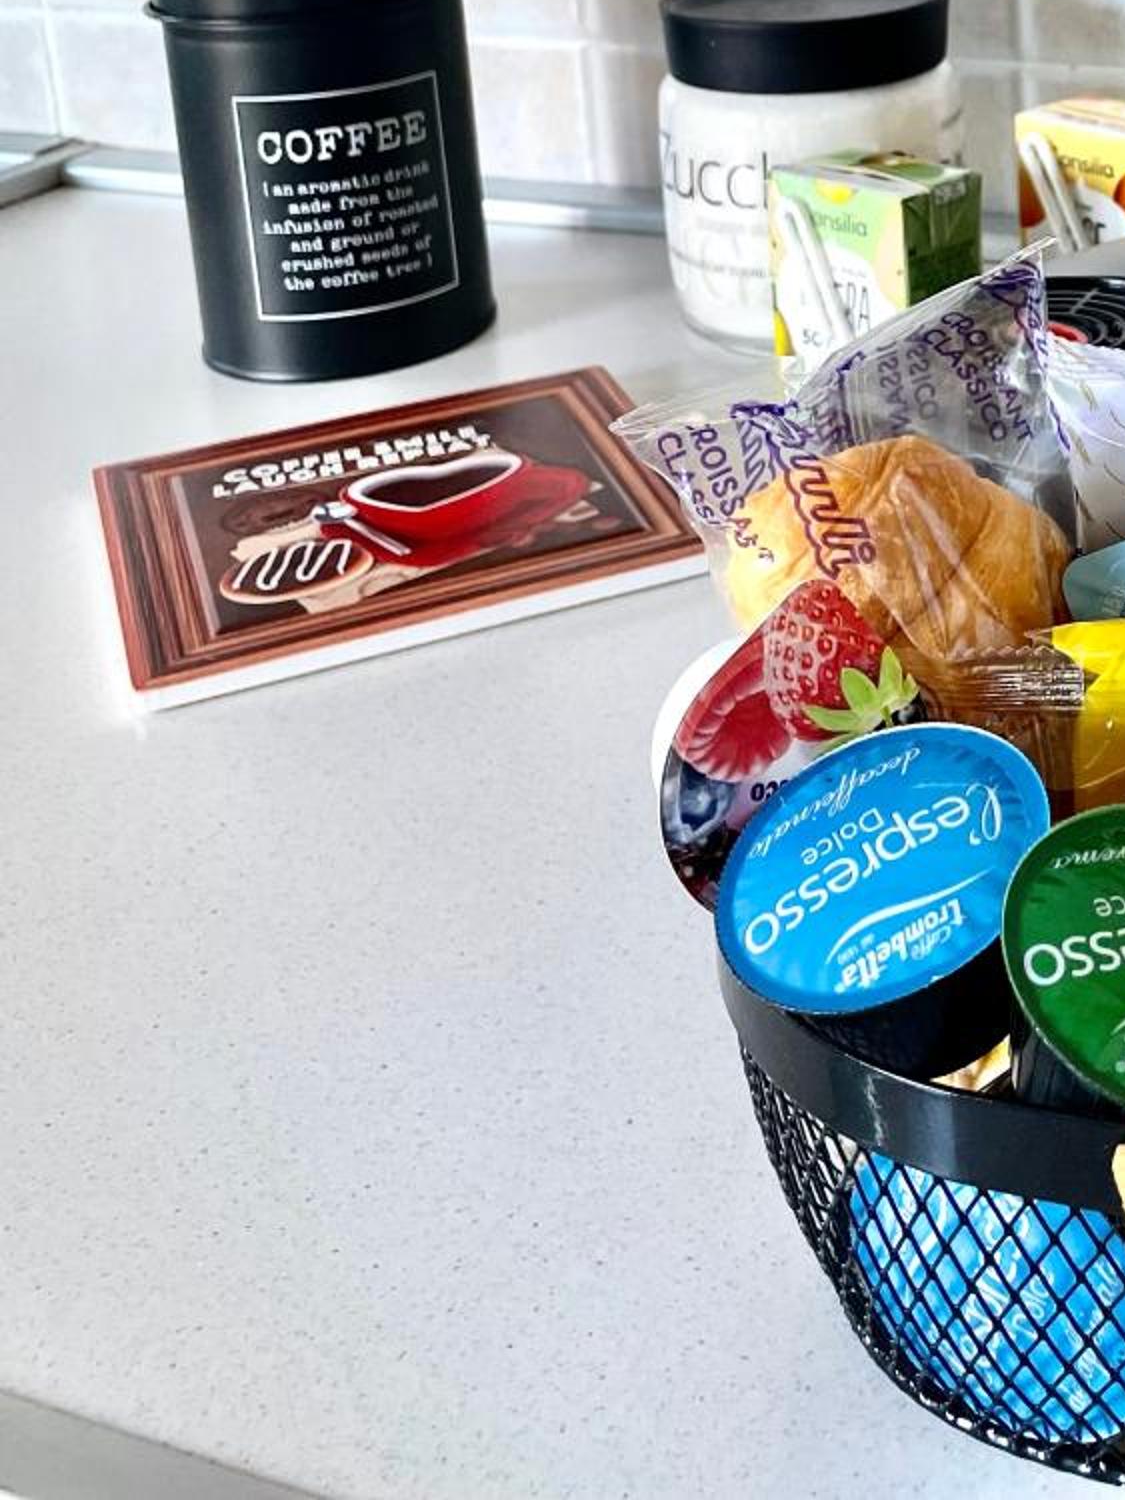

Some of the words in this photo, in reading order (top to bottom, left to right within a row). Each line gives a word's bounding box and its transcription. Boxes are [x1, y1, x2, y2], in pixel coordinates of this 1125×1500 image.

[257, 110, 427, 164] COFFEE
[288, 197, 331, 216] made
[339, 192, 380, 211] from
[386, 184, 414, 201] the
[297, 173, 381, 196] aromatic
[384, 159, 430, 184] drink
[262, 218, 345, 236] infusion
[352, 211, 373, 228] of
[379, 193, 440, 223] roasted
[290, 236, 324, 254] and
[331, 226, 395, 254] ground
[401, 222, 420, 236] or
[281, 252, 355, 273] crushed
[361, 243, 409, 264] seeds
[283, 275, 315, 291] the
[321, 268, 380, 290] coffee
[923, 329, 1008, 443] CLASSICO
[941, 311, 1035, 442] CROISSANT
[749, 746, 921, 859] decaffeinato
[802, 807, 885, 866] Dolce
[744, 783, 1002, 955] l'espresso
[842, 896, 964, 988] trombetta
